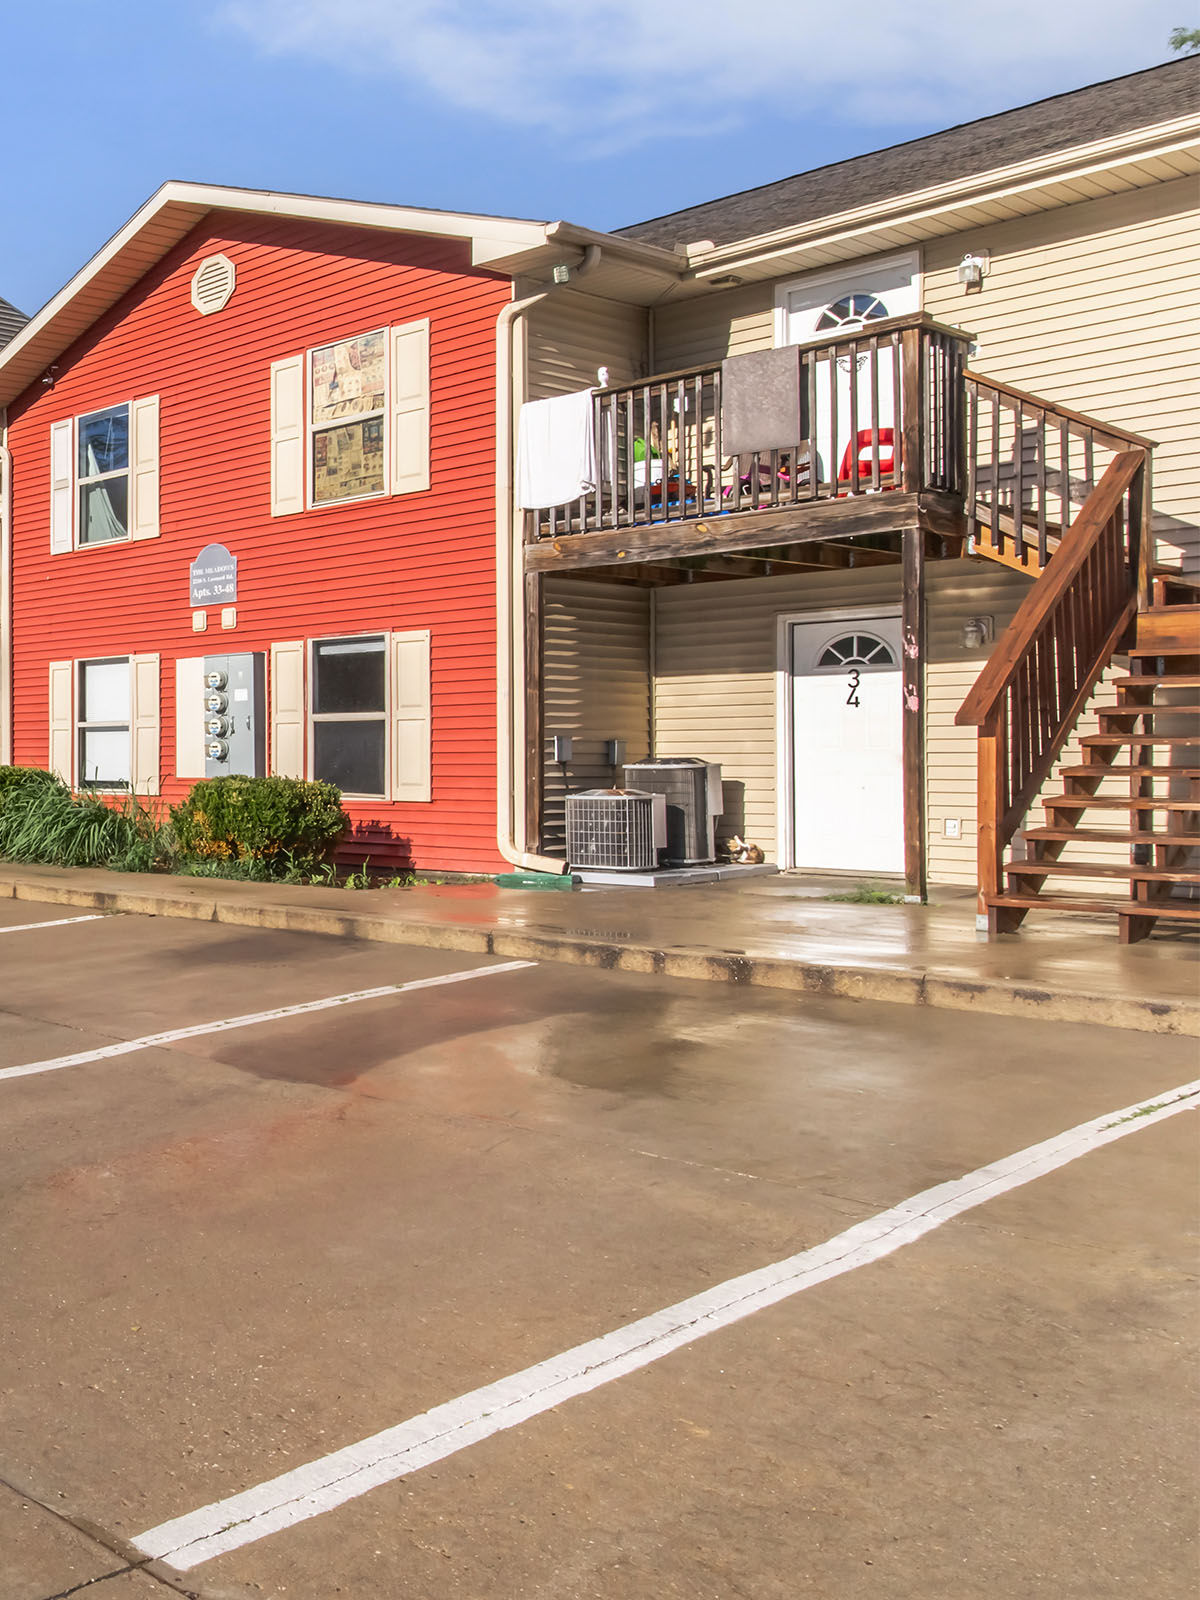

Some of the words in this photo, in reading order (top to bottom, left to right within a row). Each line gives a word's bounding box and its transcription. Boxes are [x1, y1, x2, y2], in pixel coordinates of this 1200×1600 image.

[192, 588, 212, 600] Apts.
[212, 583, 235, 596] 33-48
[846, 668, 861, 708] 34
